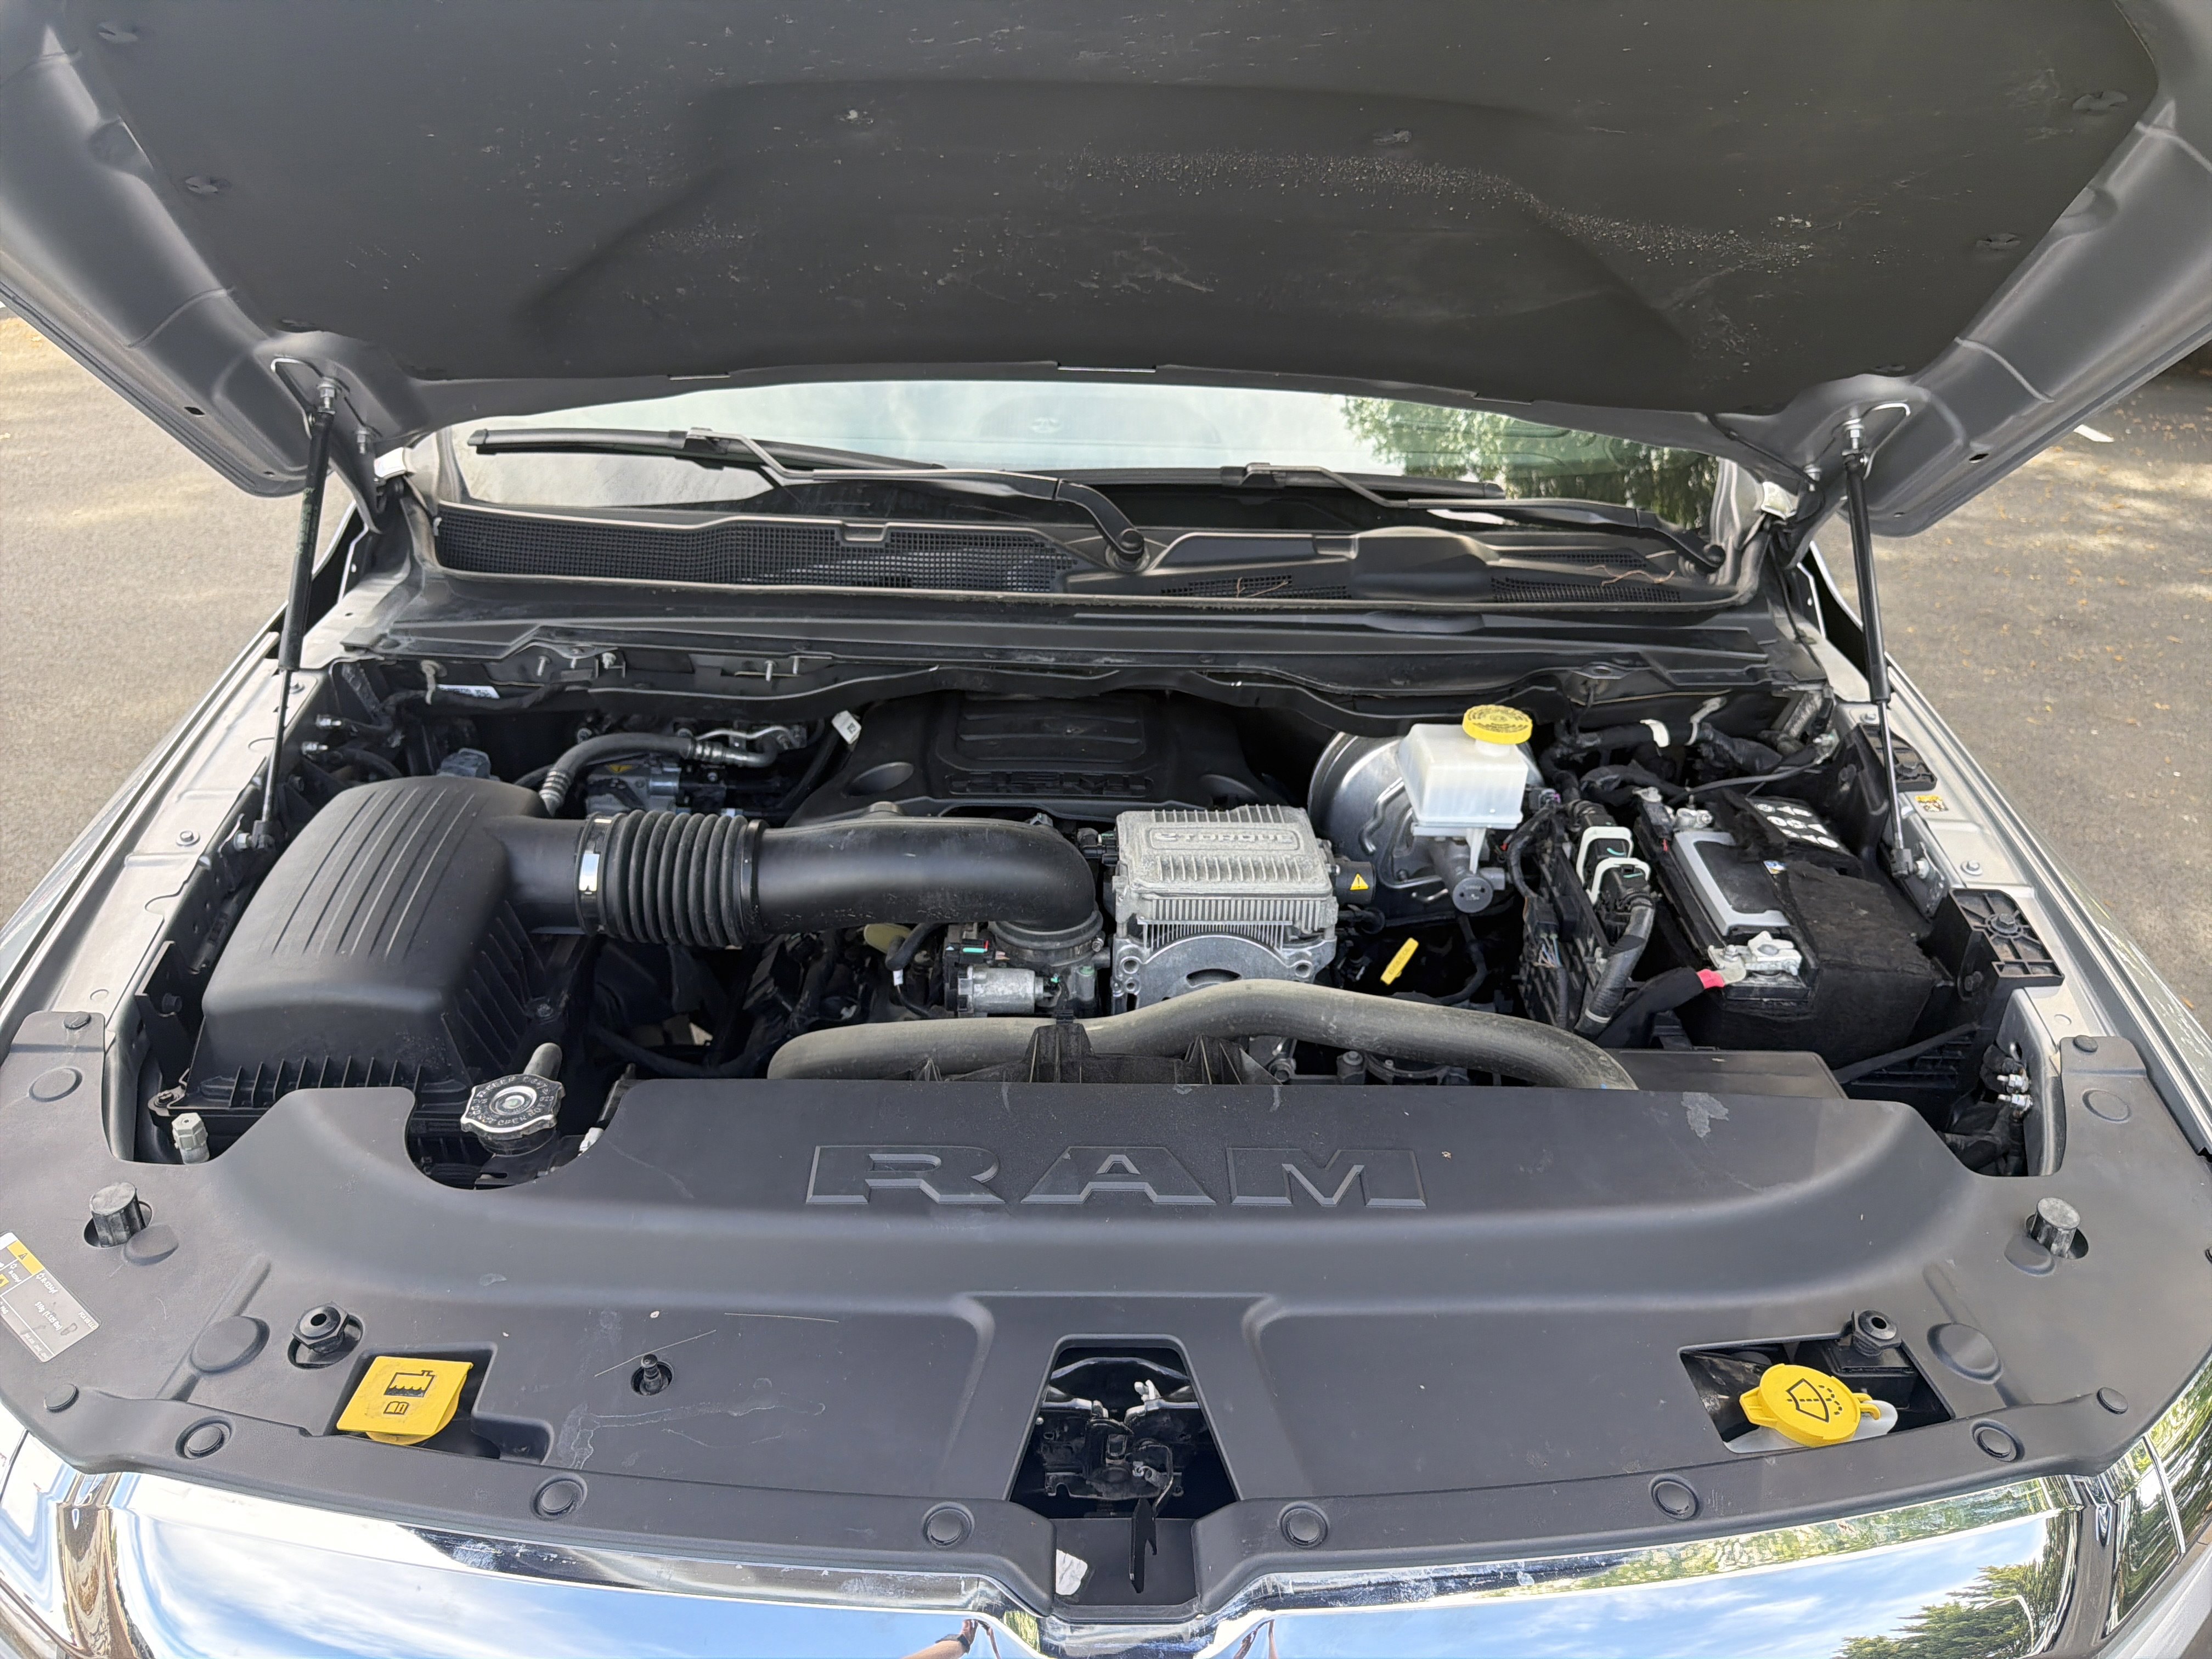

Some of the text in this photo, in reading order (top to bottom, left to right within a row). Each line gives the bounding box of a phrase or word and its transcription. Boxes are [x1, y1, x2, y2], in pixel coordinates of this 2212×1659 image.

[805, 1145, 1426, 1207] RAM
[40, 1278, 58, 1294] R-1234yf
[78, 1311, 87, 1319] FCA
[88, 1321, 97, 1329] LLC
